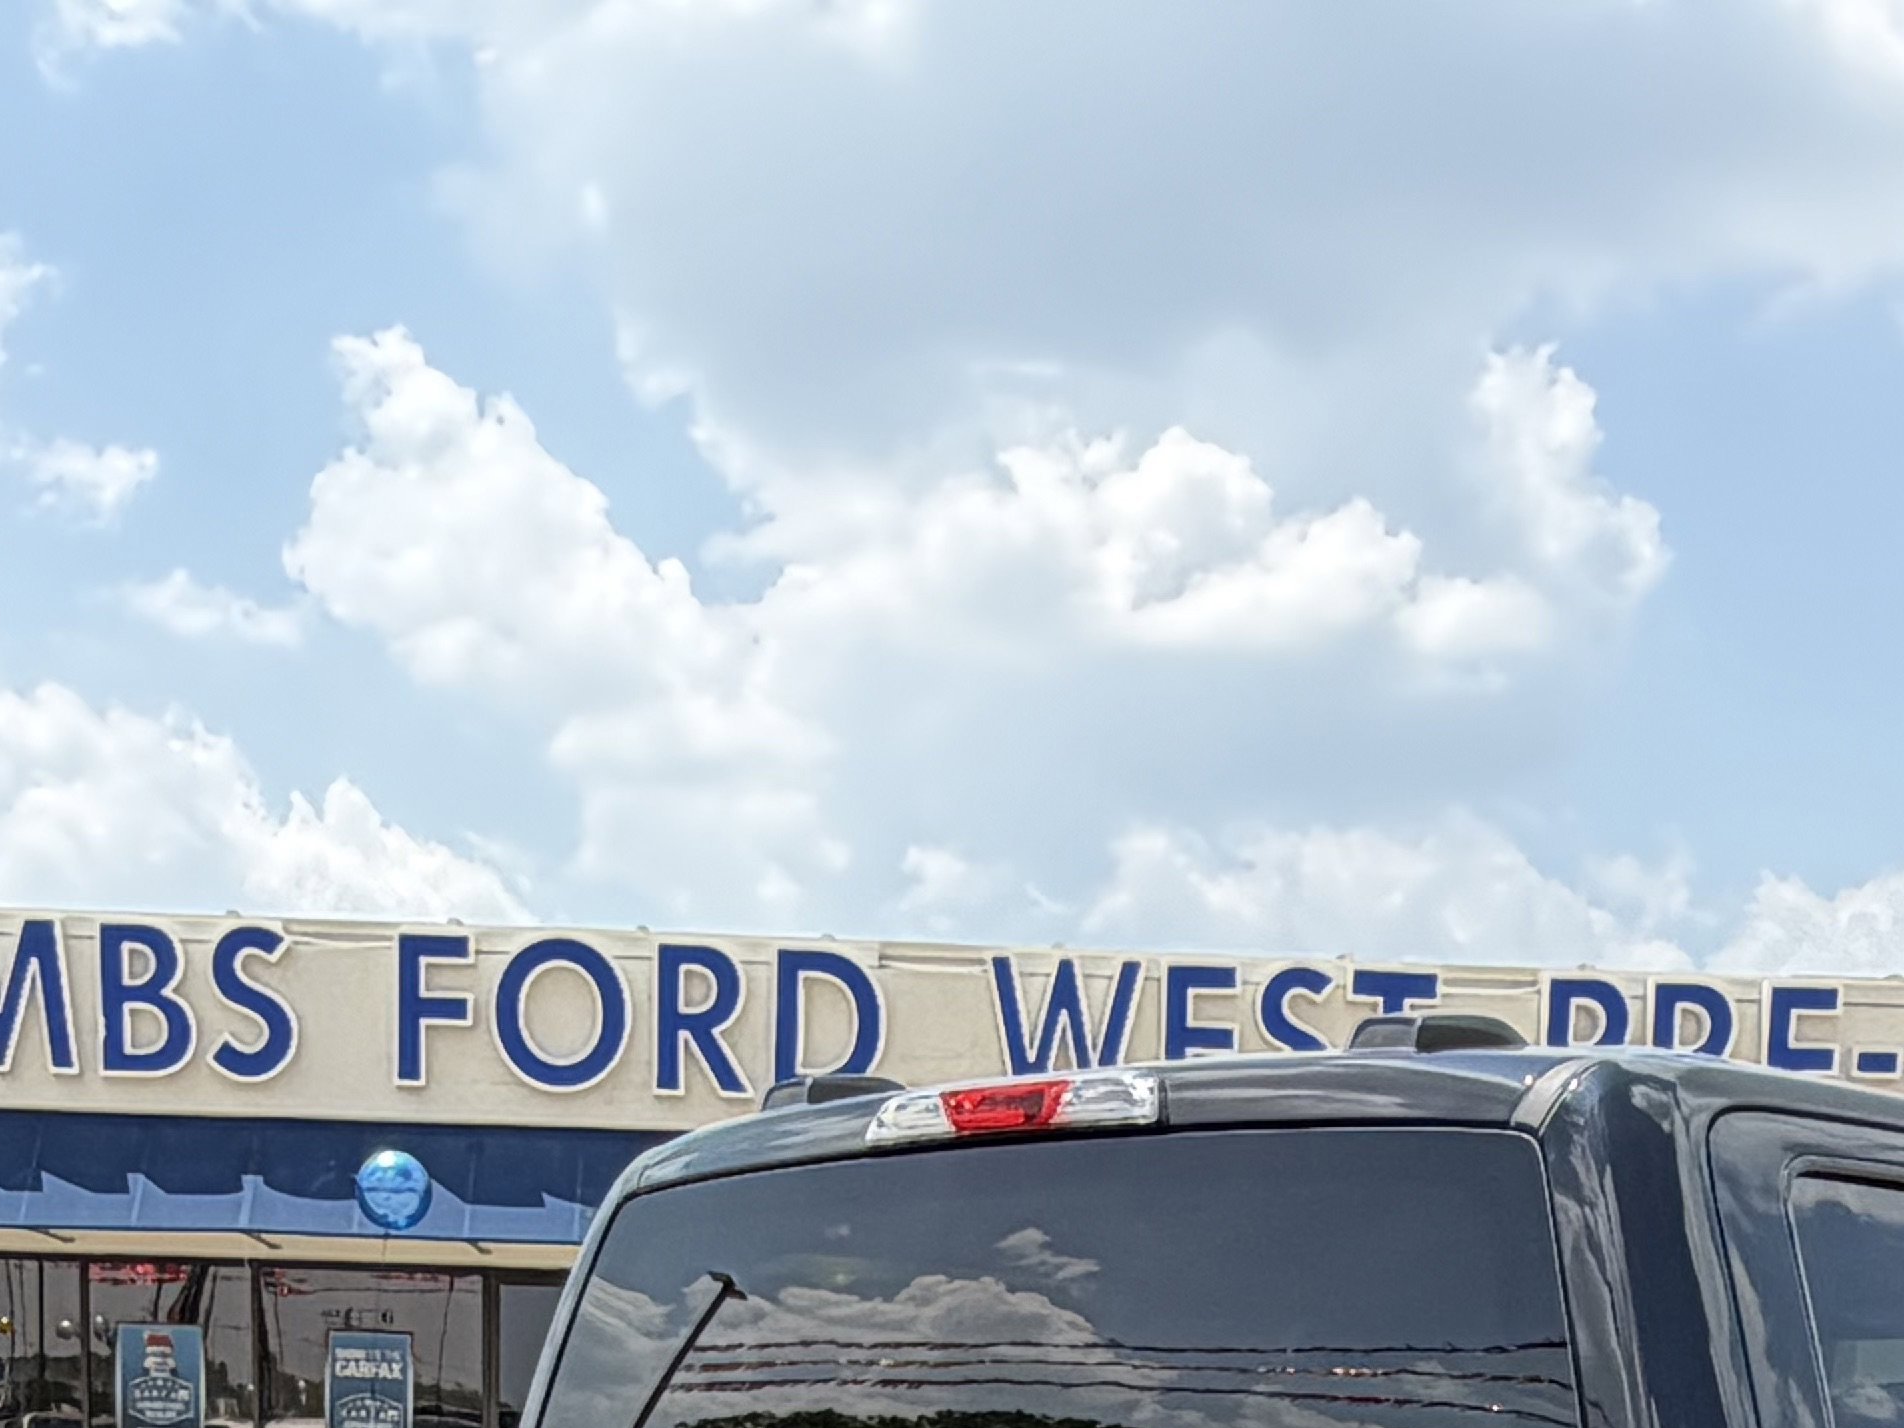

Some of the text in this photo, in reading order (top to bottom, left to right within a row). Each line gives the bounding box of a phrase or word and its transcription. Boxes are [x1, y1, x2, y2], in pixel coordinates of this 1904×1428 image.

[396, 932, 884, 1095] FORD
[991, 955, 1440, 1077] WEST
[334, 1360, 404, 1380] CARFAX
